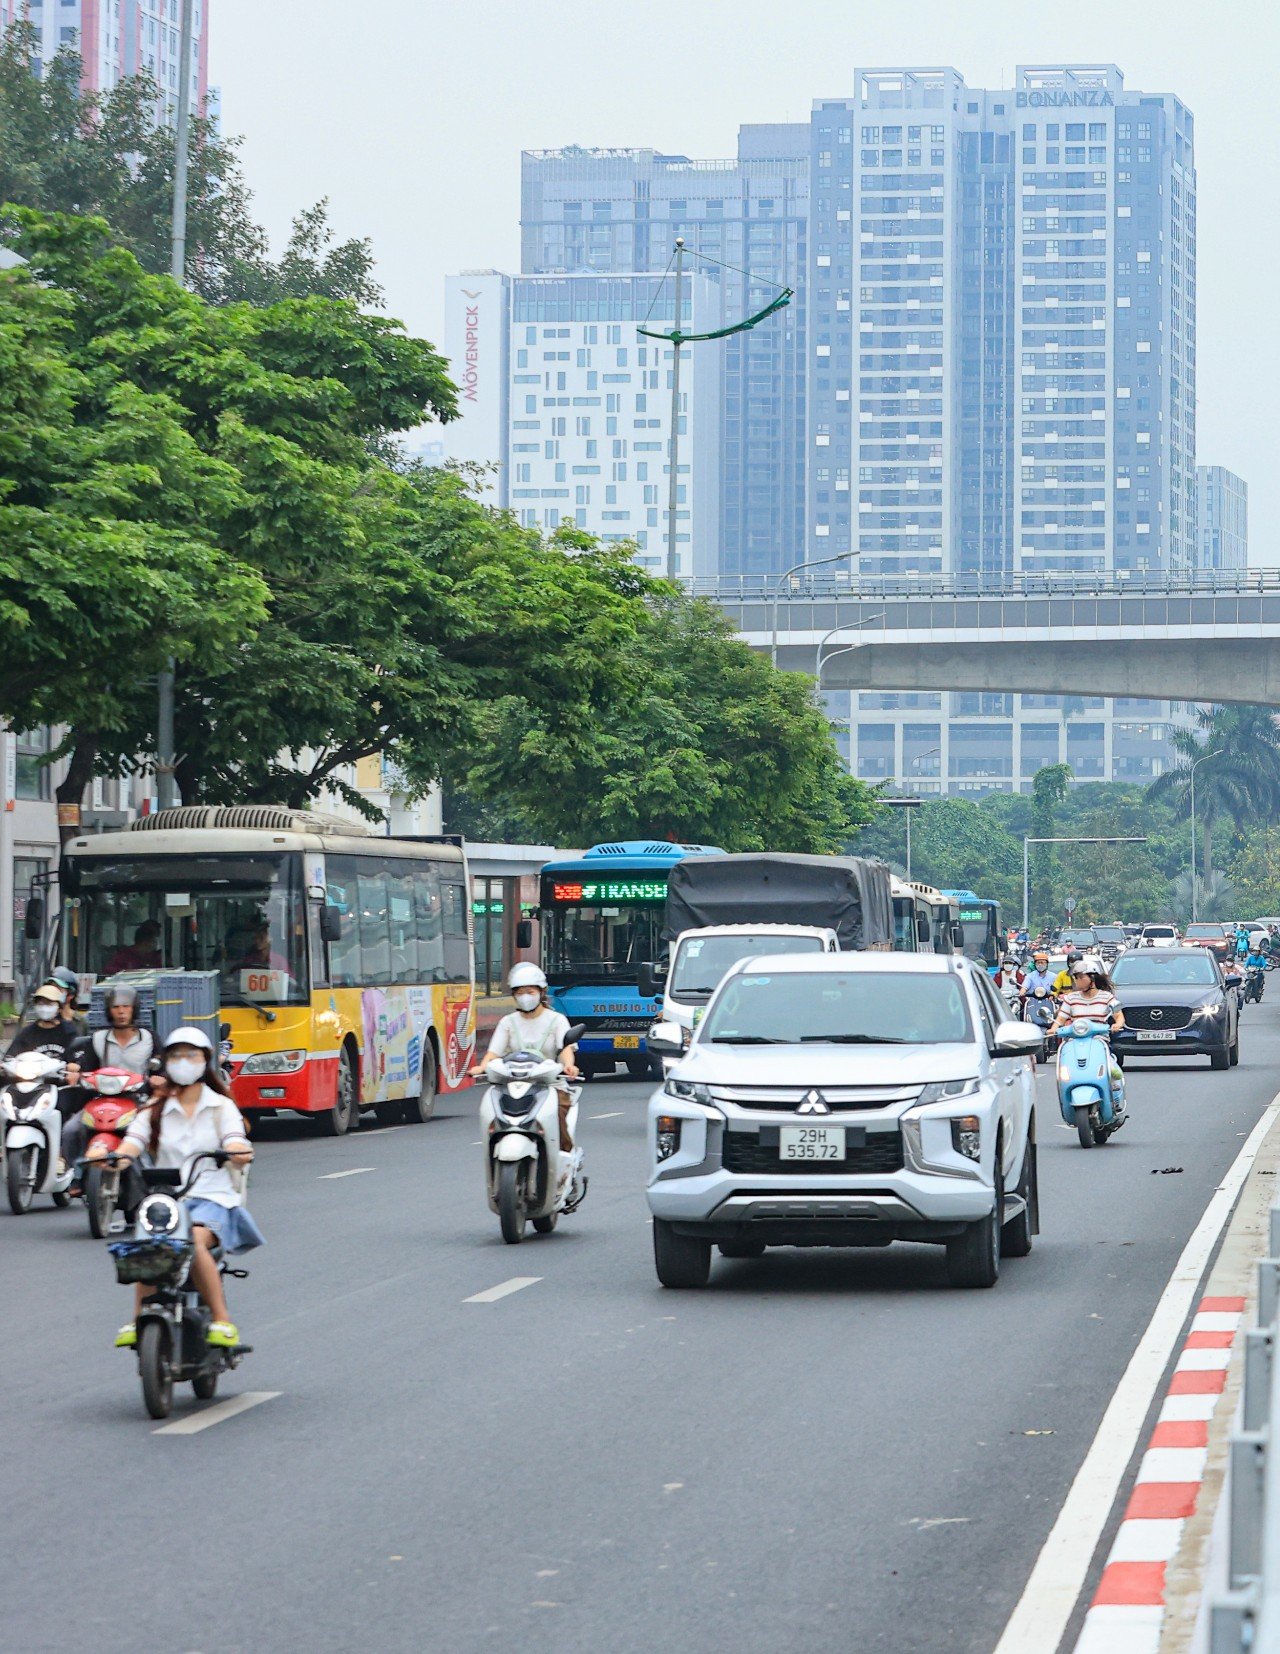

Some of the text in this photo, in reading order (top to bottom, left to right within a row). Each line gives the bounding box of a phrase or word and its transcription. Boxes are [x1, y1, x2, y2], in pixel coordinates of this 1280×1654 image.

[1016, 90, 1114, 107] BONANZA
[462, 305, 479, 402] MÖVENPICK
[608, 1004, 628, 1013] BUS
[799, 1129, 827, 1143] 29H
[787, 1144, 838, 1159] 535.72
